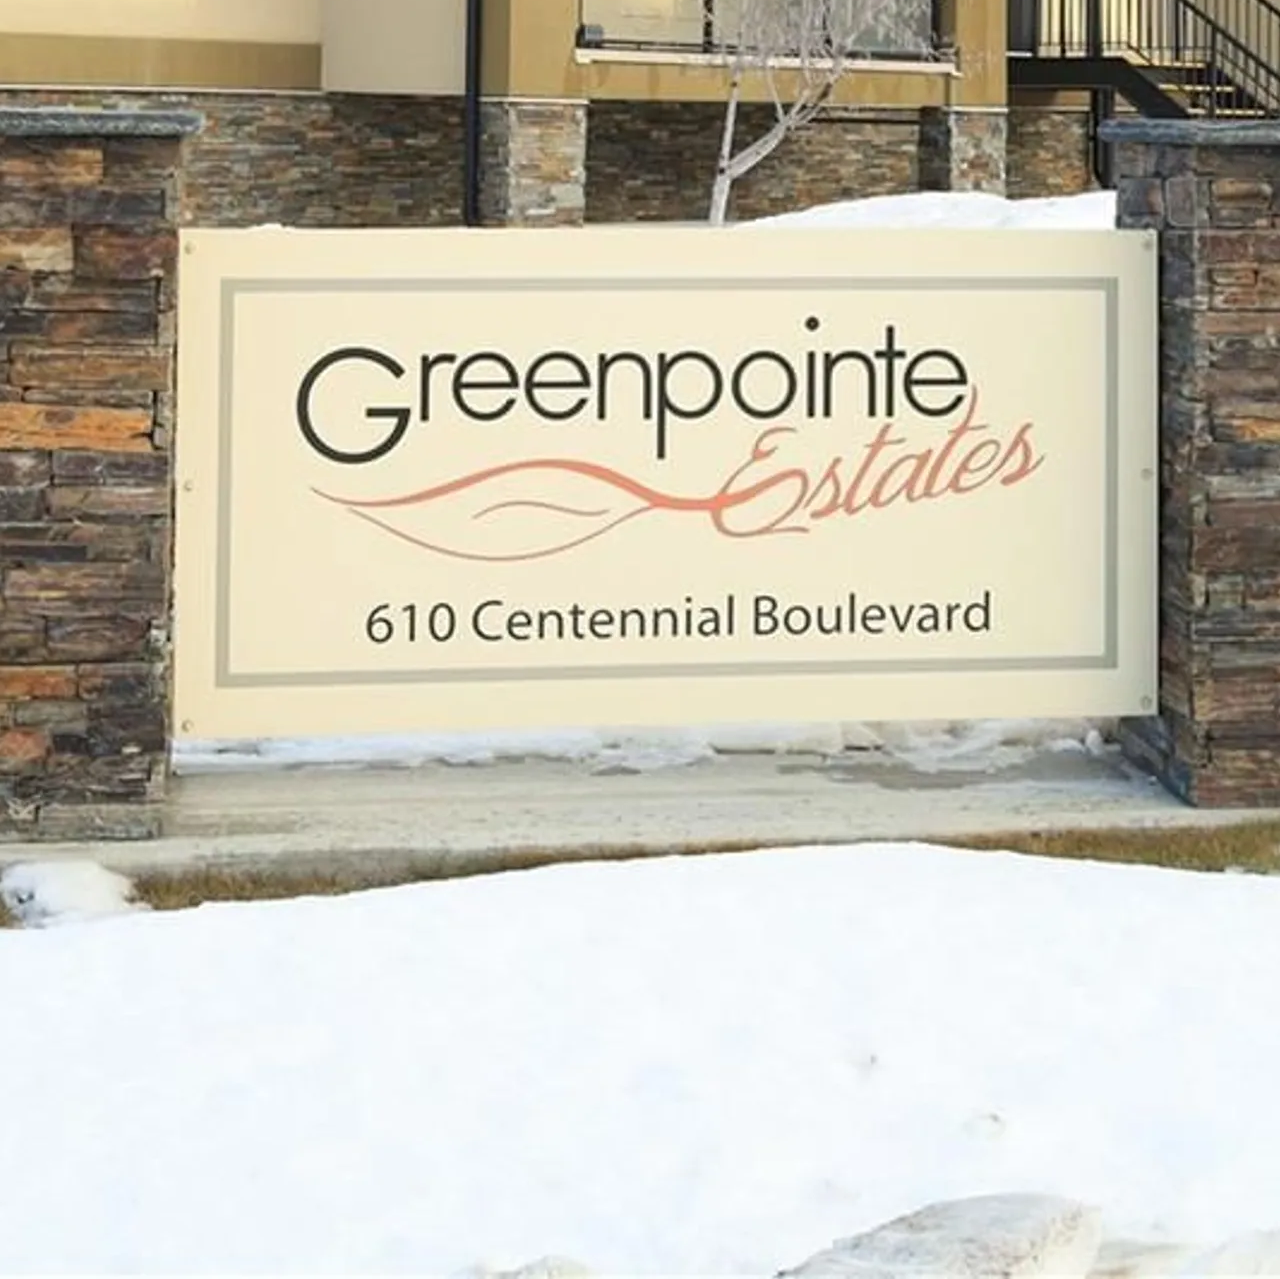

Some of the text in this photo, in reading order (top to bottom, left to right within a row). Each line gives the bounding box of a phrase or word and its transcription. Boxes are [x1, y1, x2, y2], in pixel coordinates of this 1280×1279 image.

[296, 316, 968, 465] Greenpointe
[712, 385, 1045, 537] Estates
[366, 590, 990, 644] 610 Centennial Boulevard
